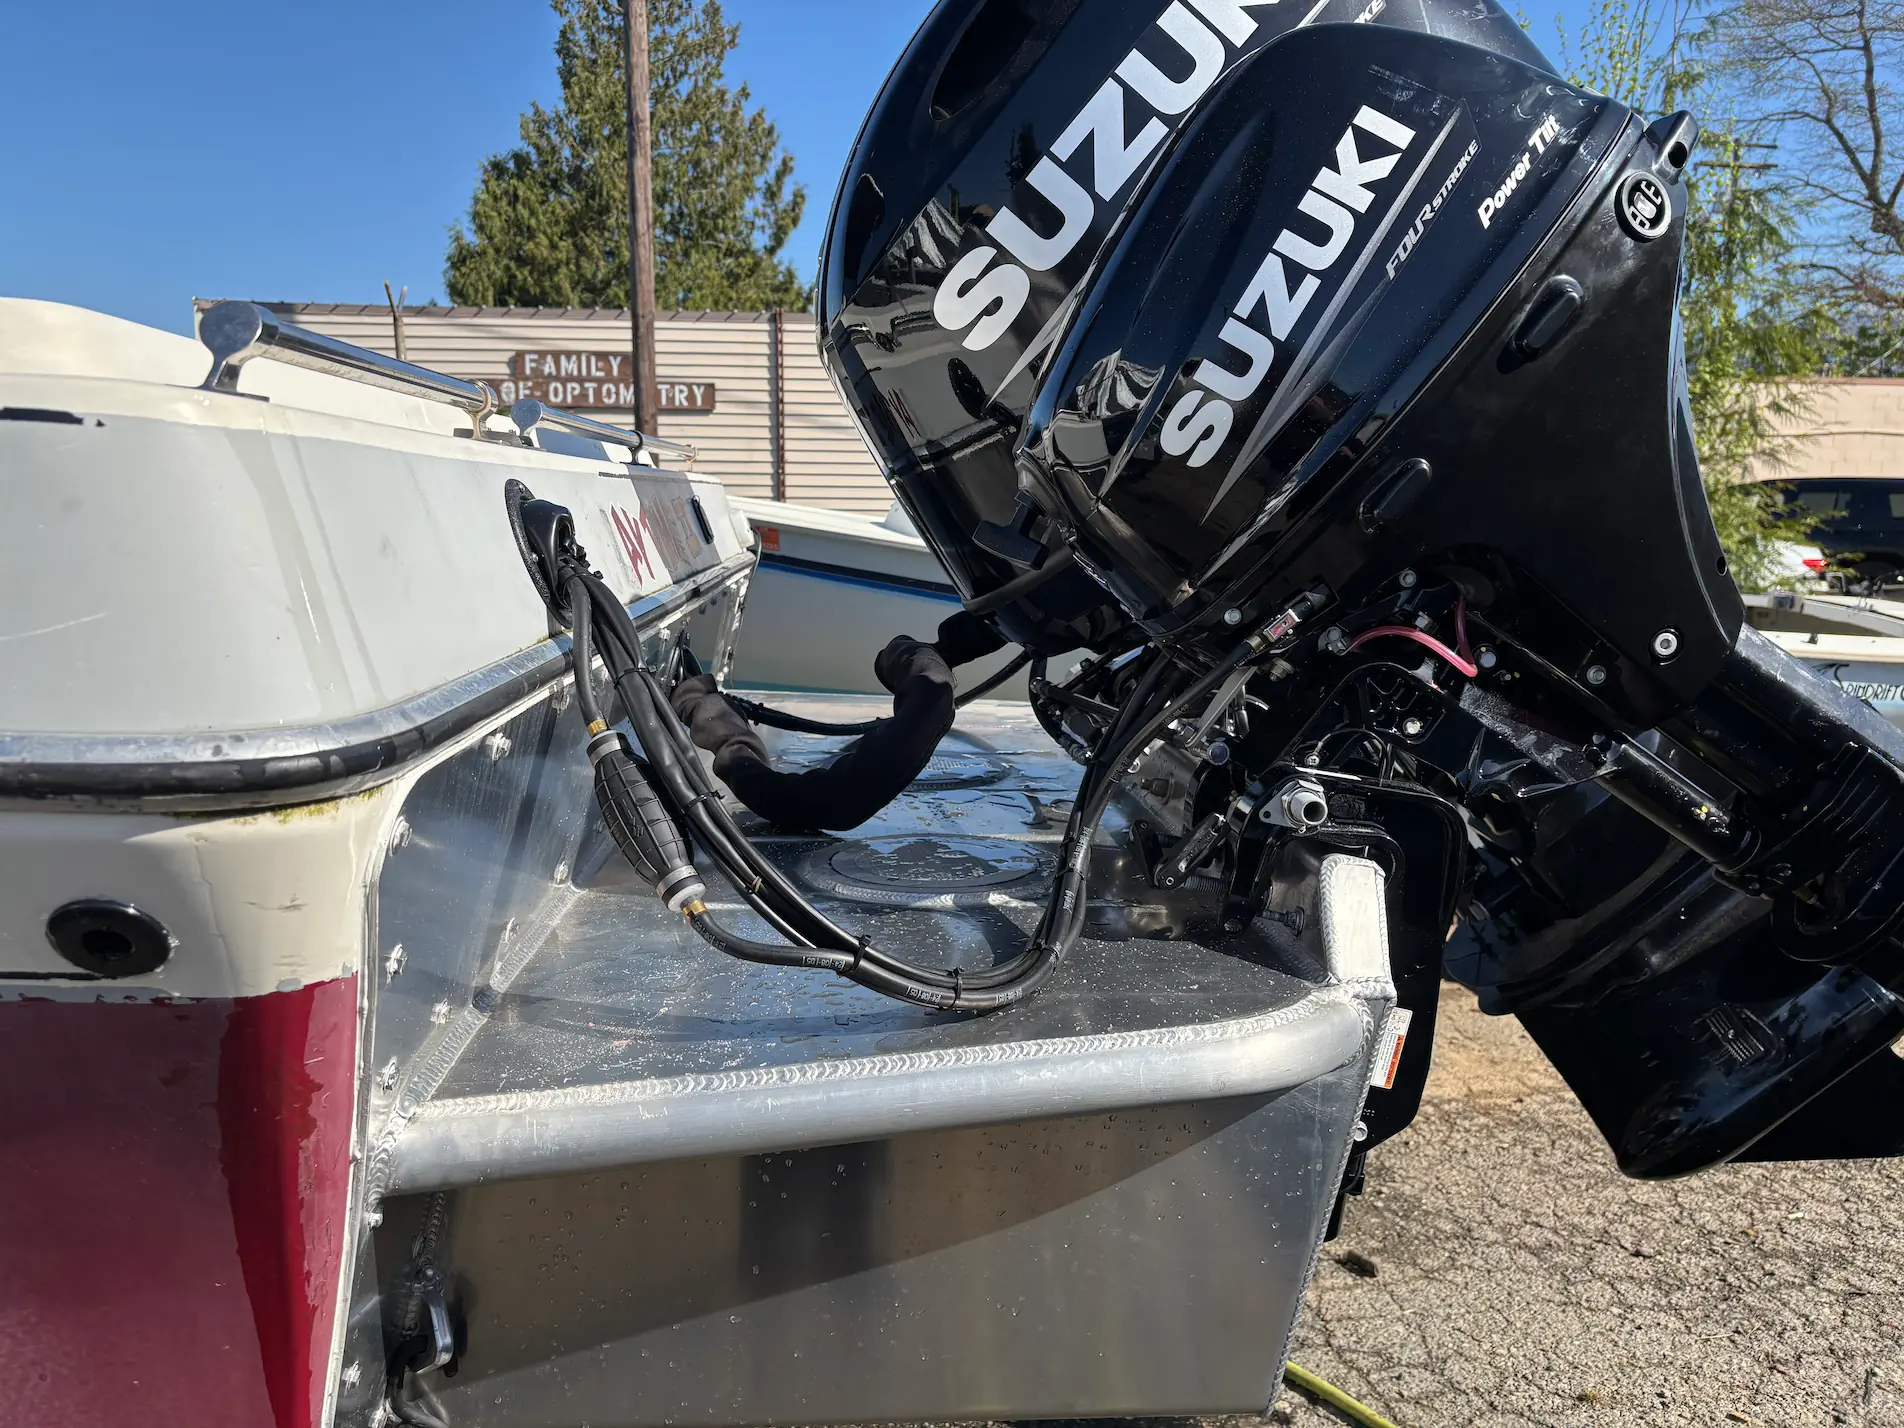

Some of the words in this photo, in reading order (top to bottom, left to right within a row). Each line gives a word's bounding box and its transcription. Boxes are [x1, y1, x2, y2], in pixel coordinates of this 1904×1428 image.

[1478, 152, 1531, 229] Power
[1528, 114, 1560, 154] Tilt
[1160, 105, 1416, 467] SUZUKI
[523, 353, 623, 377] FAMILY
[549, 381, 705, 407] OPTOMTRY
